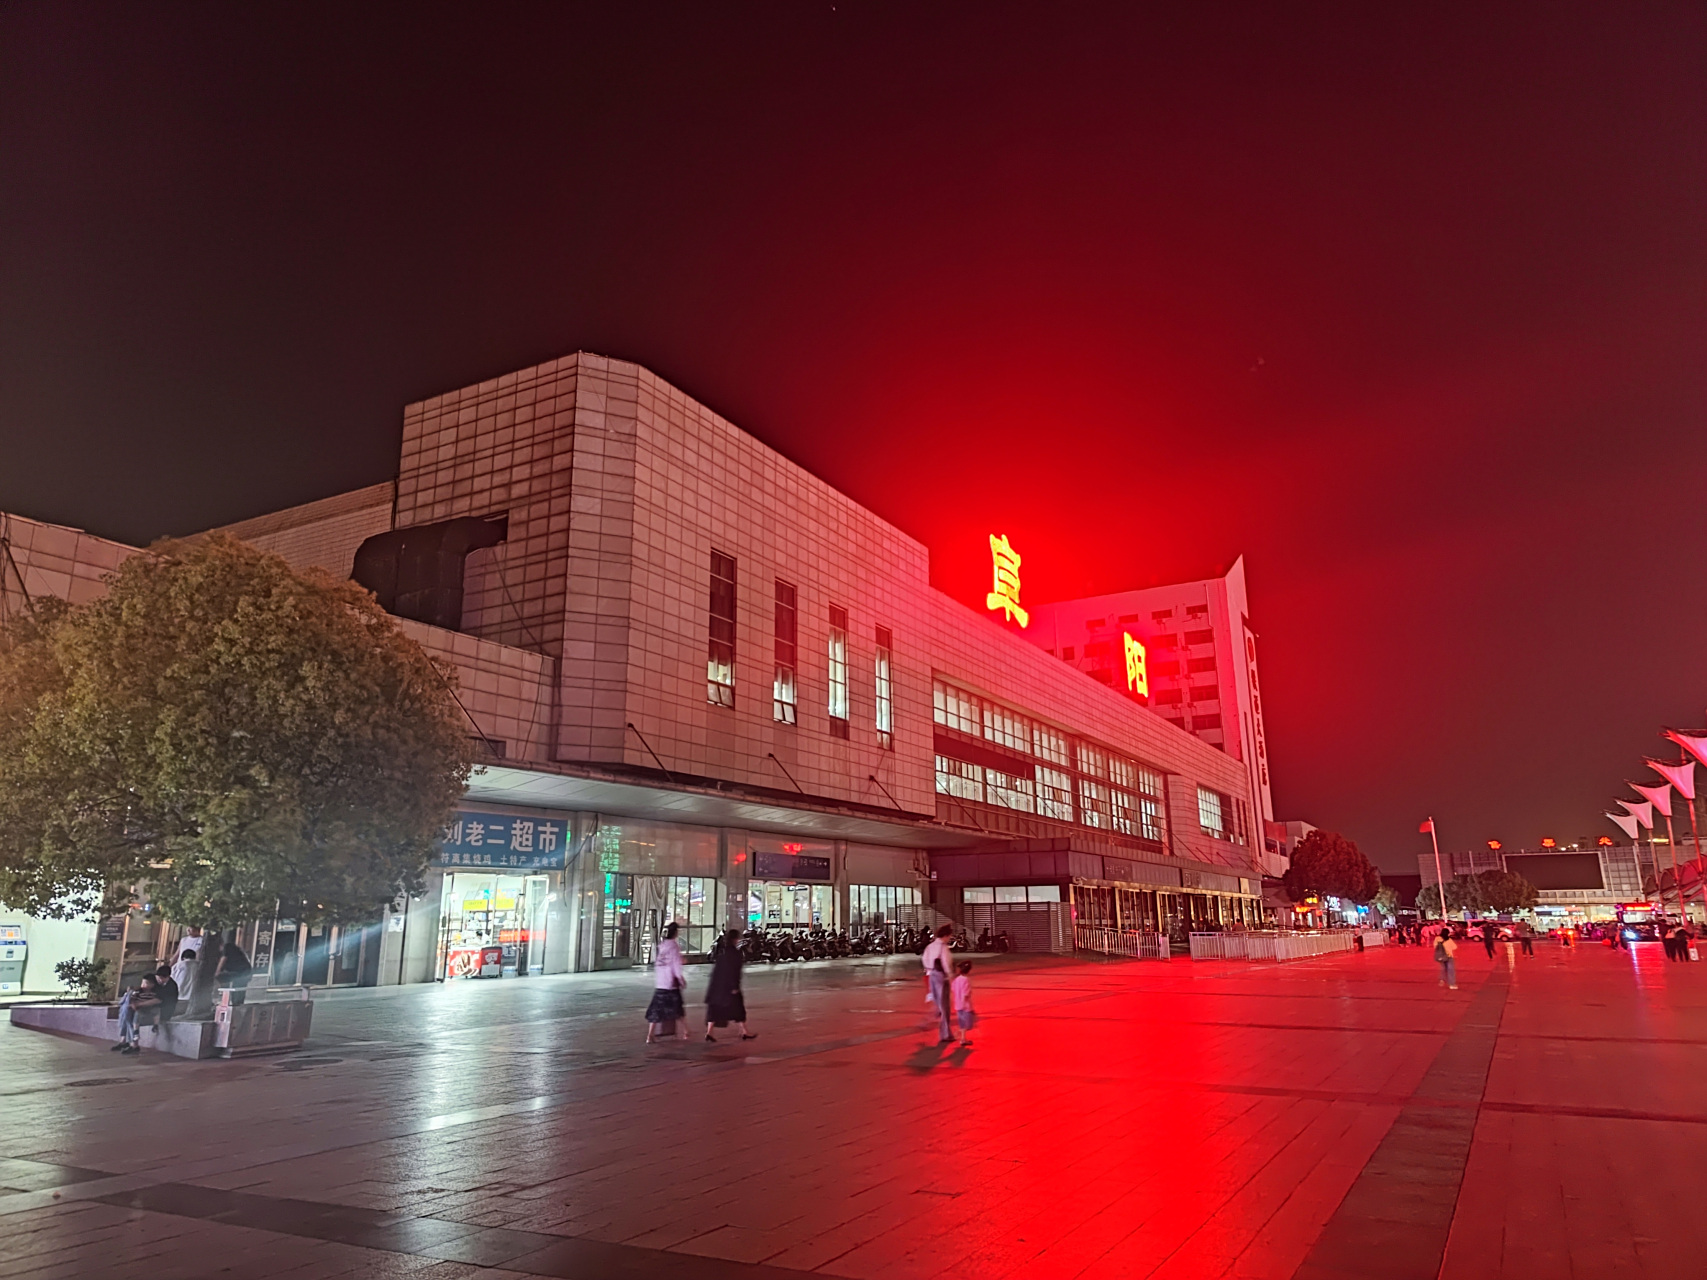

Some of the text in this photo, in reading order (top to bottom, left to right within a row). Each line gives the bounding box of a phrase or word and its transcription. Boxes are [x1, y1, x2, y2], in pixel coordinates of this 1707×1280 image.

[987, 533, 1148, 698] 阜 阳
[442, 819, 559, 853] 刘老二超市
[500, 855, 527, 866] 土特产
[254, 919, 272, 968] 寄存
